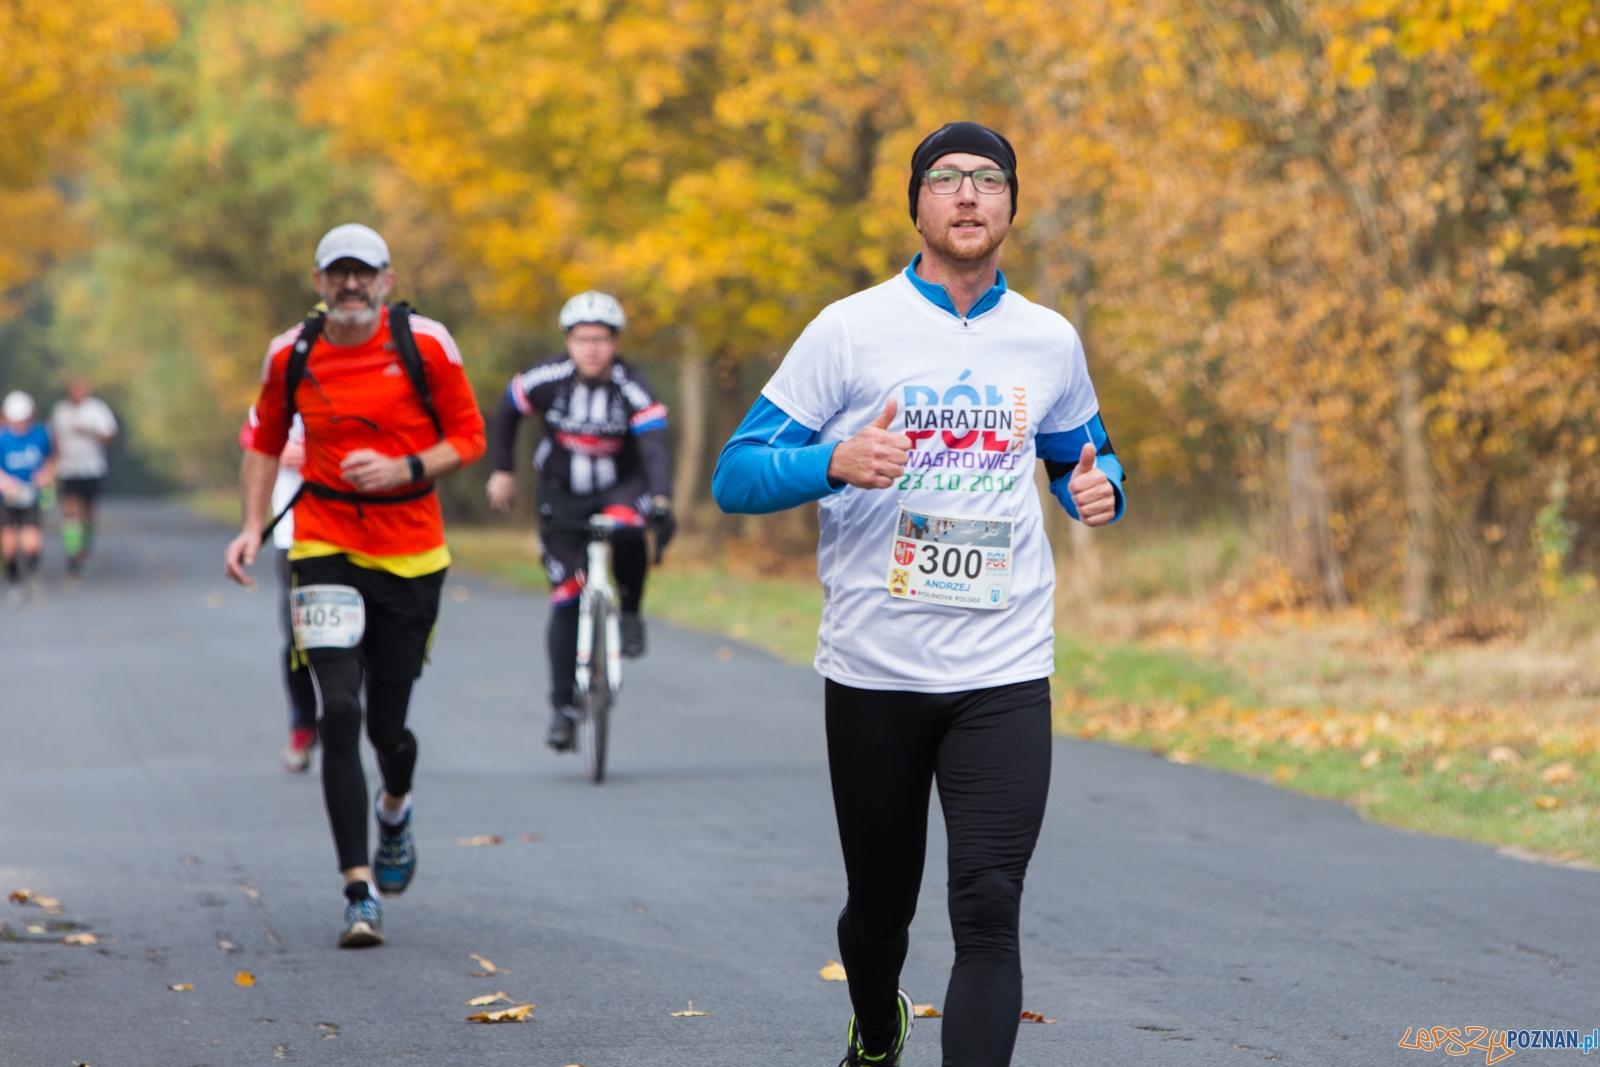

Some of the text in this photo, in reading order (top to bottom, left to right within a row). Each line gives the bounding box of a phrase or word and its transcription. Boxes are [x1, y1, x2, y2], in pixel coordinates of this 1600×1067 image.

[904, 409, 1012, 430] MARATON
[1010, 386, 1027, 452] SKOKI
[918, 544, 983, 579] 300
[924, 579, 971, 592] ANDRZEJ
[954, 594, 981, 604] POLSKA
